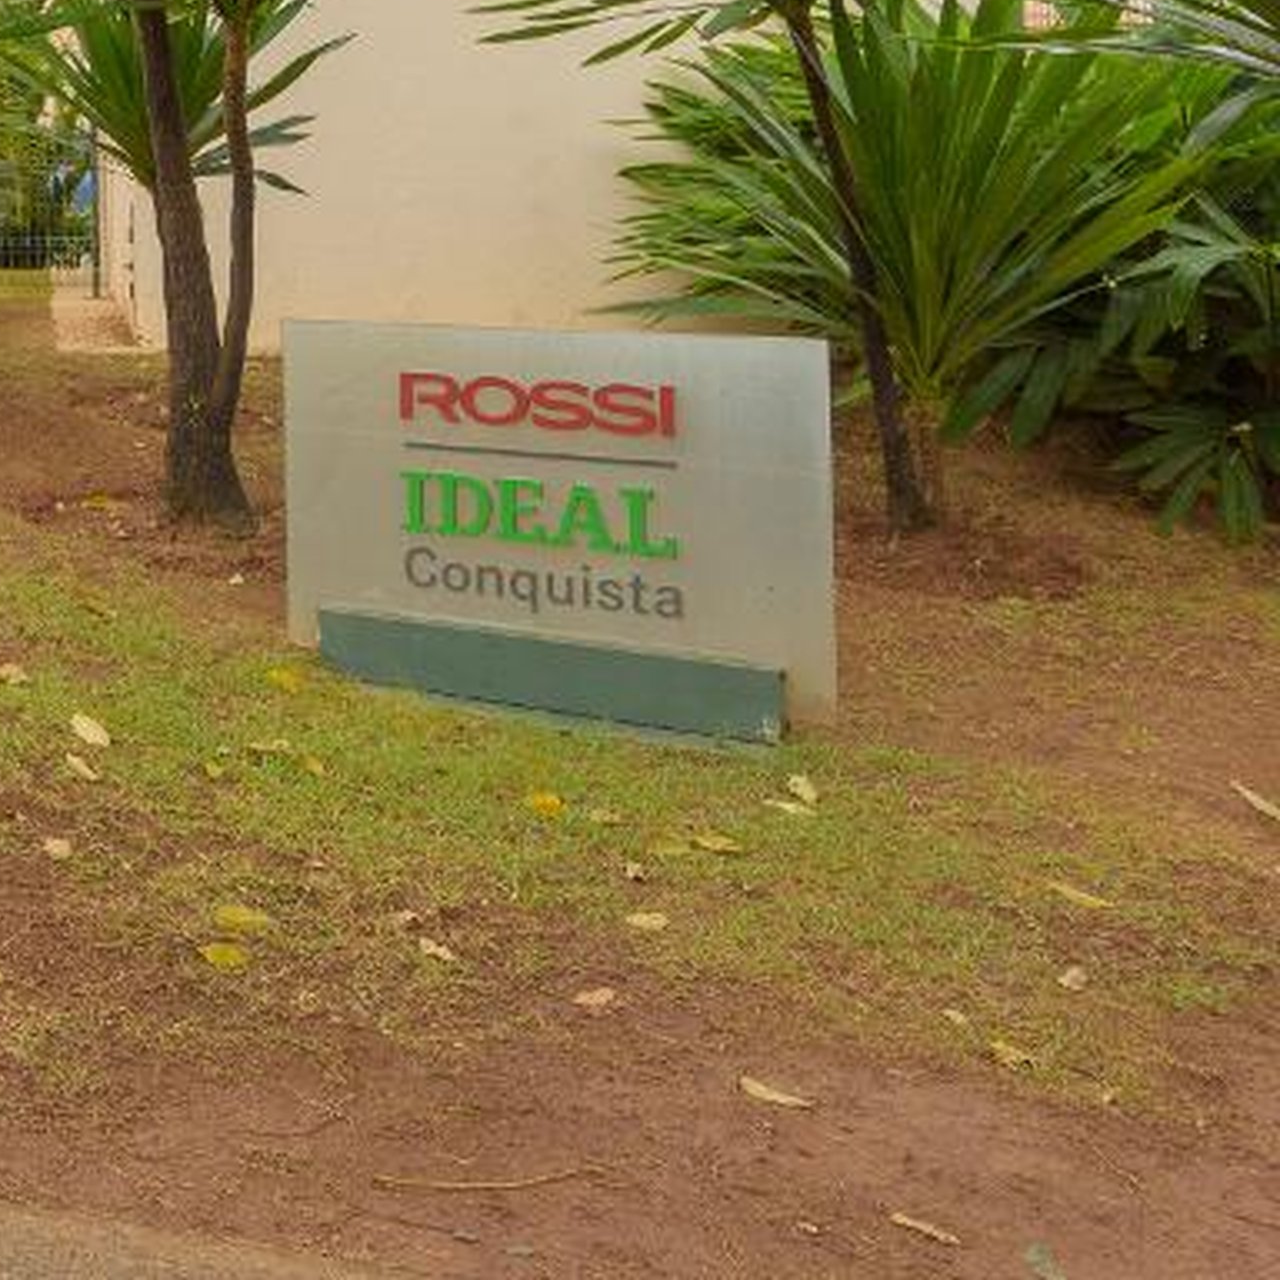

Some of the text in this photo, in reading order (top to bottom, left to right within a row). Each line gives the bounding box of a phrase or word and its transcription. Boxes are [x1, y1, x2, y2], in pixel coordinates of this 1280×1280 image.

[399, 372, 677, 438] ROSSI
[399, 470, 679, 560] IDEAL
[404, 546, 684, 618] Conquista
